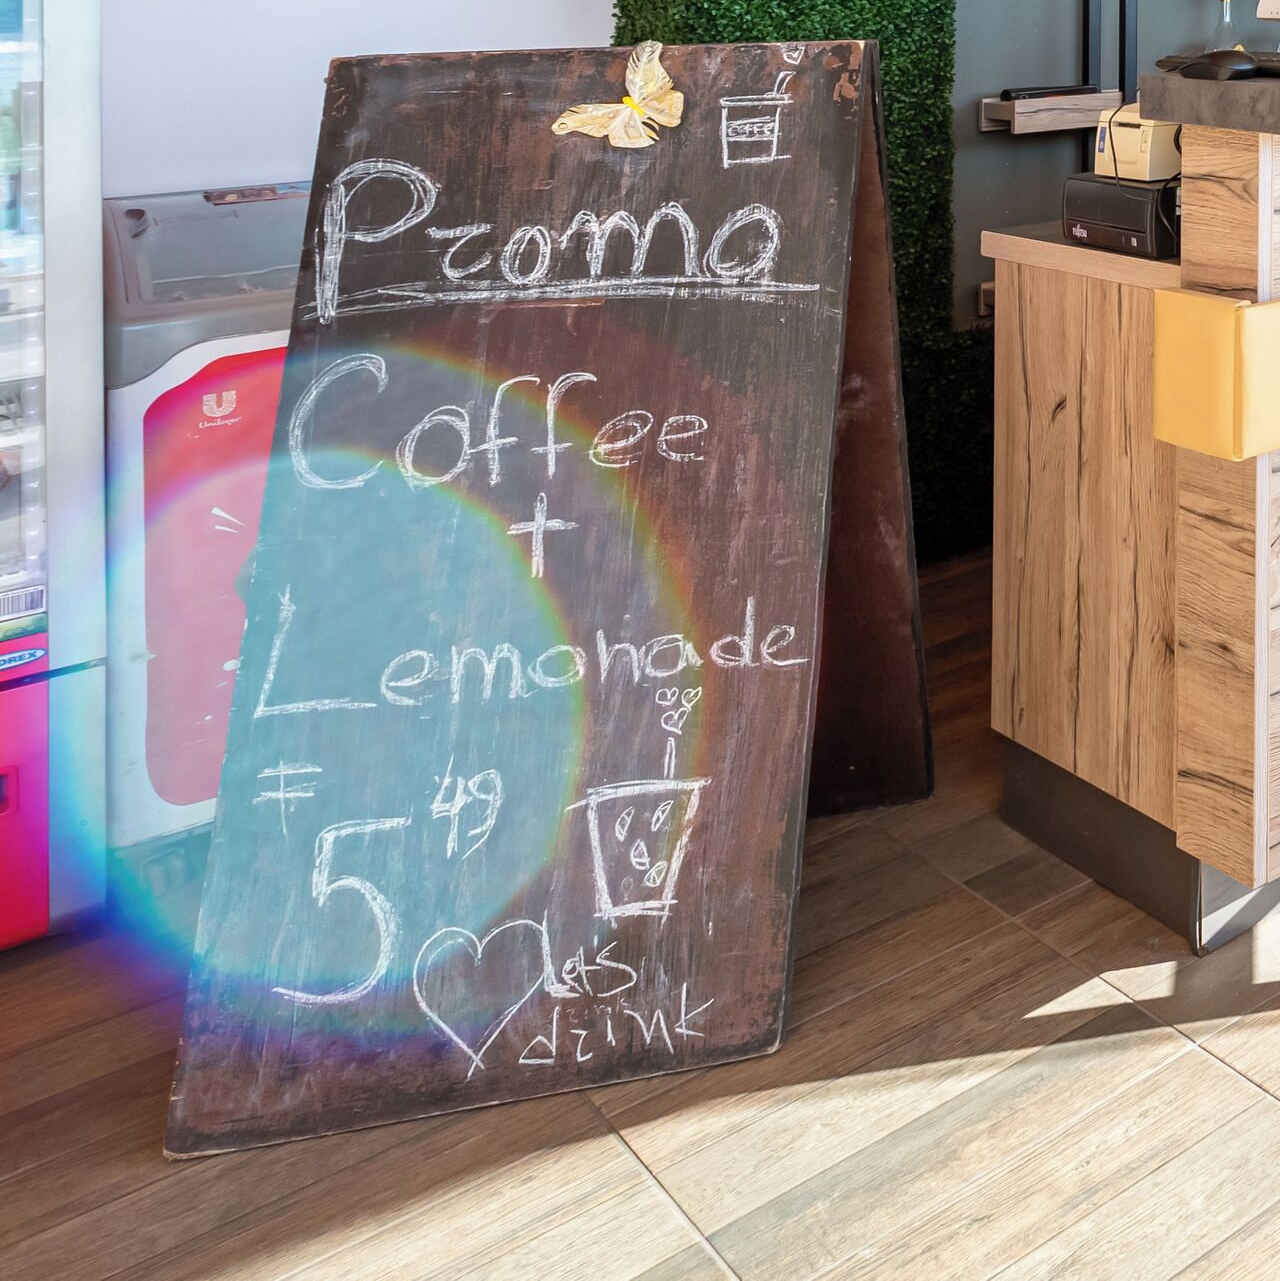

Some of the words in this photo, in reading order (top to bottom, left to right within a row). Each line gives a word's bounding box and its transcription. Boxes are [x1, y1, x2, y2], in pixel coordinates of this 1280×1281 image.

[313, 157, 785, 325] Promo
[289, 353, 709, 490] Coffee
[253, 585, 810, 718] Lemonade
[271, 816, 413, 1005] 5
